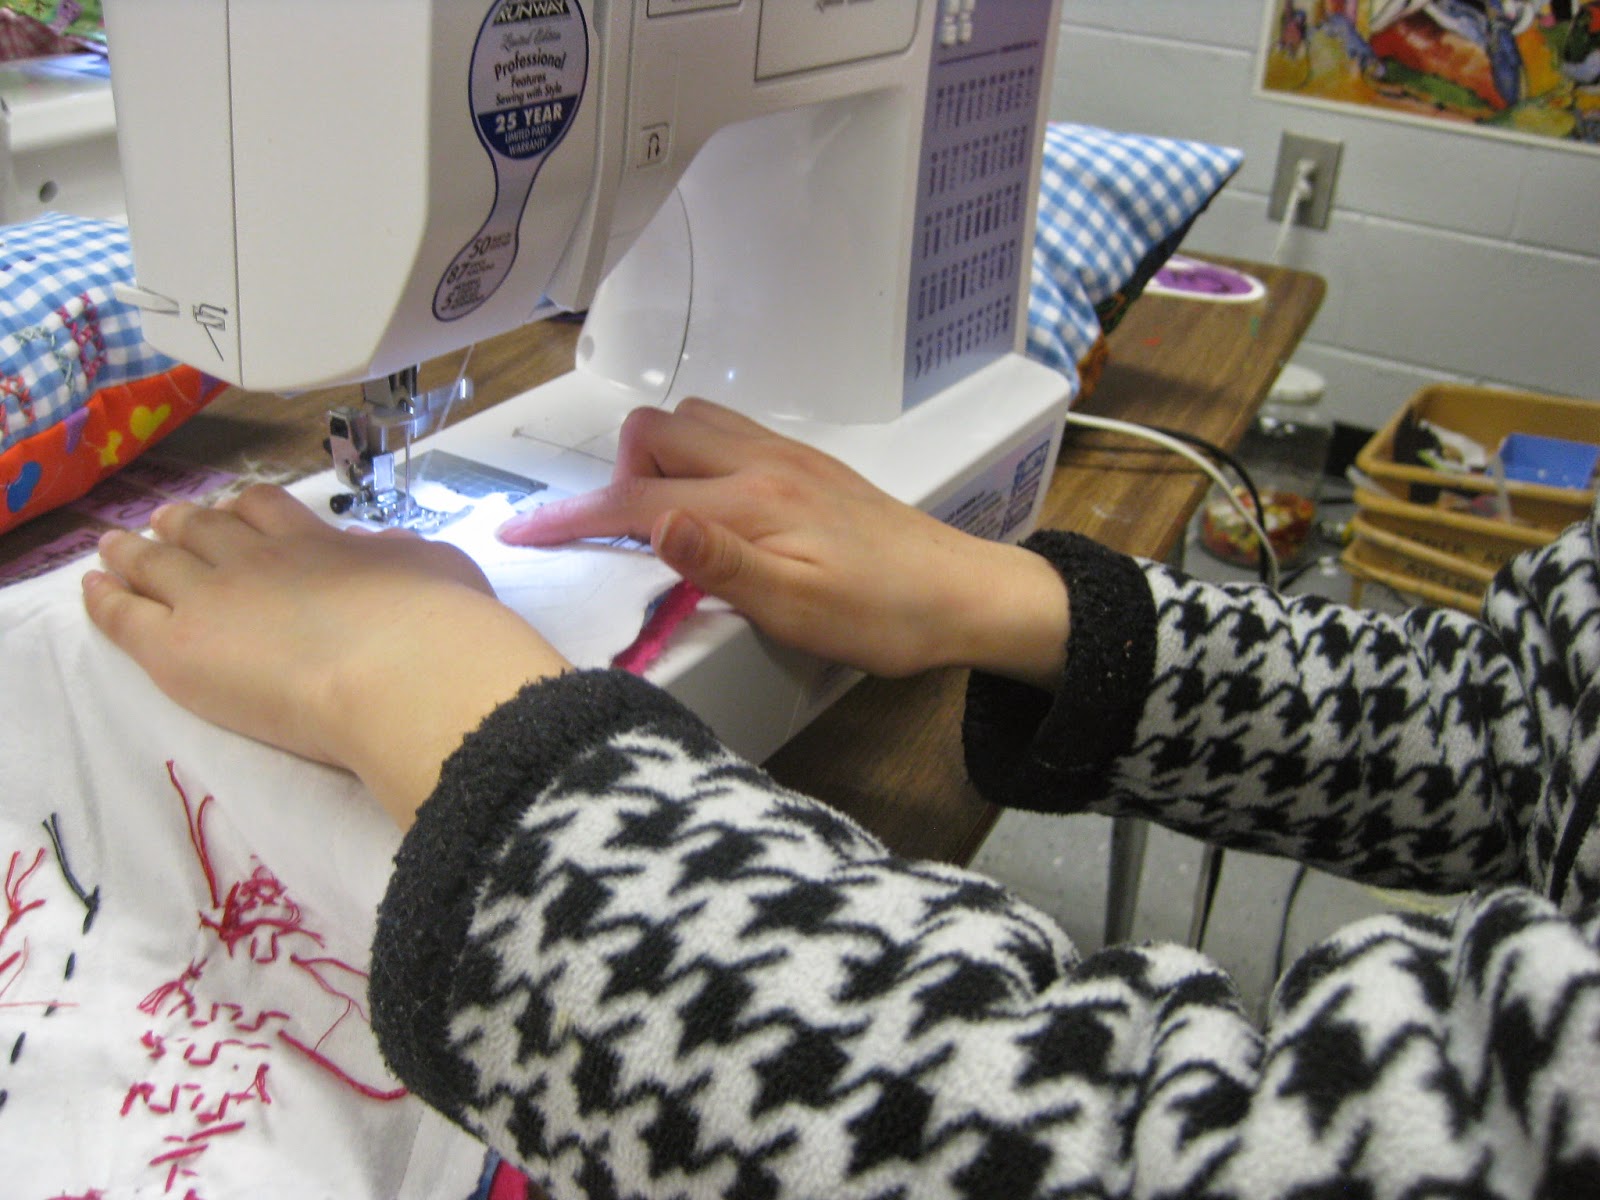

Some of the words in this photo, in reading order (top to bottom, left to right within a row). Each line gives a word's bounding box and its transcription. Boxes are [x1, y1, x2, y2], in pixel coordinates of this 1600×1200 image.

[496, 1, 566, 22] RUNWAY
[495, 47, 567, 81] Professional
[511, 73, 546, 89] Features
[496, 92, 524, 105] Sewing
[526, 86, 543, 100] with
[545, 80, 562, 98] Style
[495, 111, 517, 134] 25
[523, 102, 562, 126] YEAR
[505, 128, 530, 144] LIMITED
[508, 137, 547, 156] WARRANTY
[469, 235, 491, 257] 50
